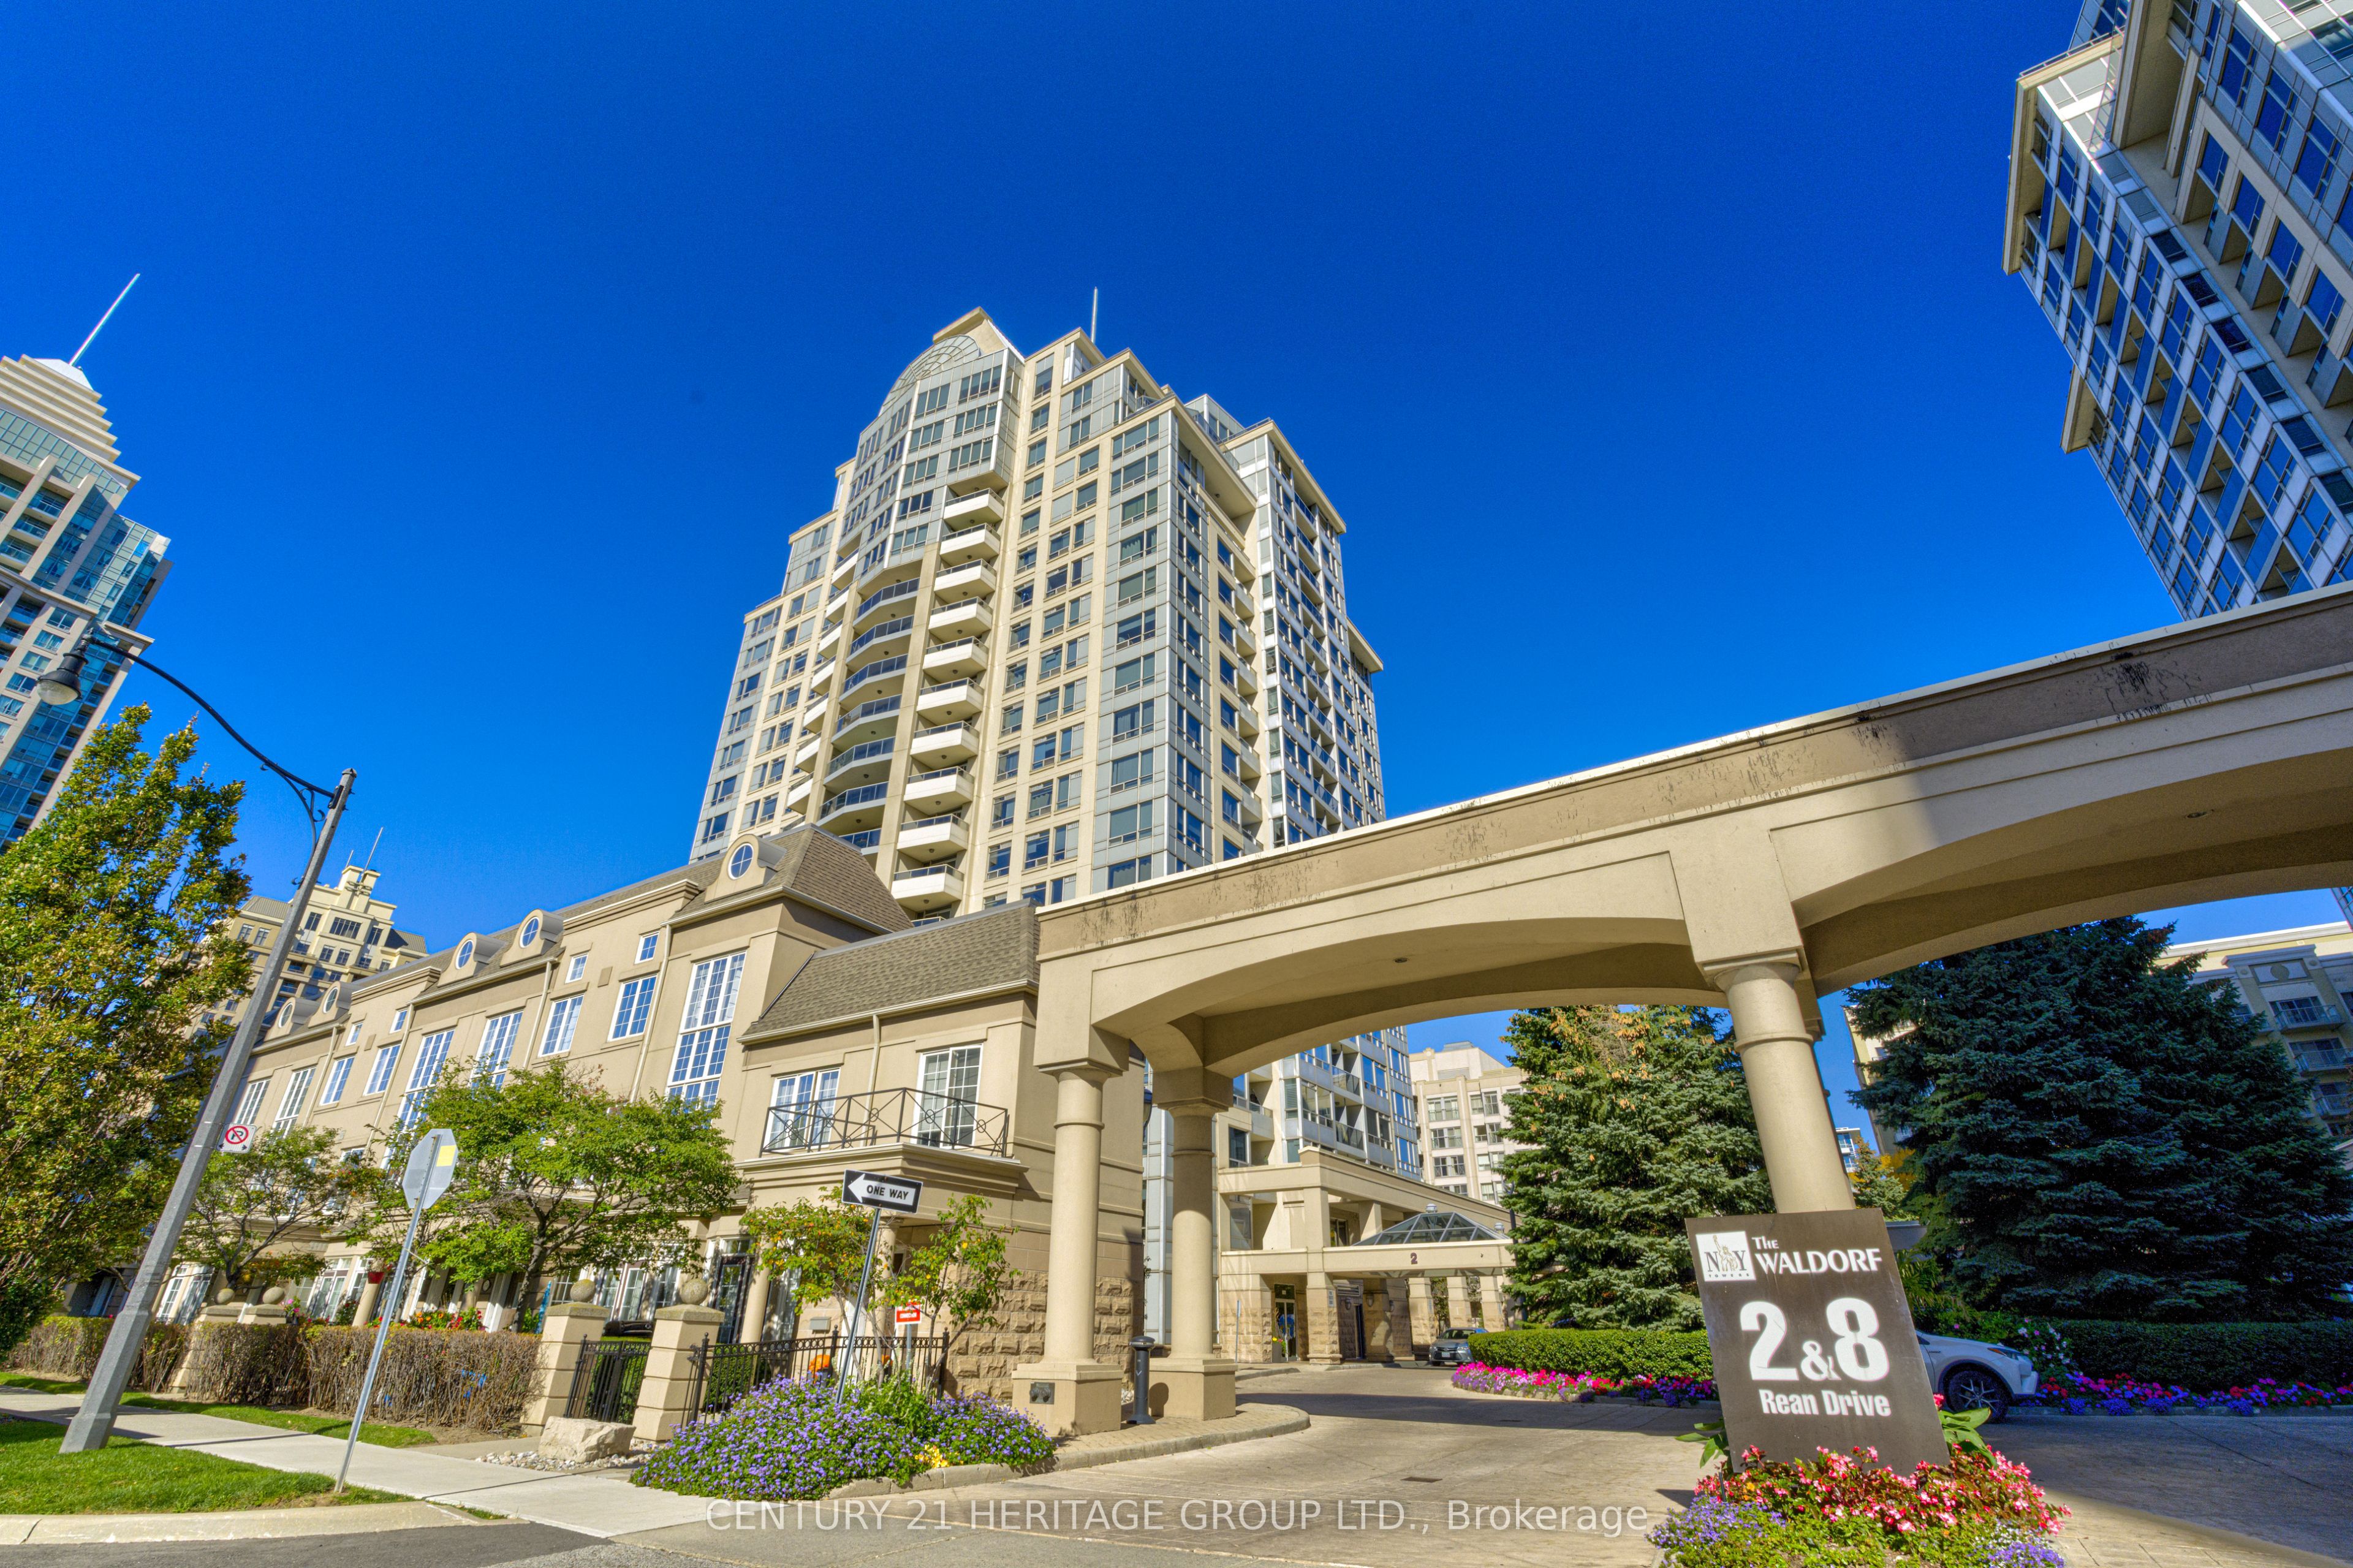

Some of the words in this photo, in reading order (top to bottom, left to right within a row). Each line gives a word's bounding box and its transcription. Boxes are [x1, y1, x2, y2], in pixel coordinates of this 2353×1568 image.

[866, 1184, 885, 1196] ONE
[889, 1188, 909, 1200] WAY
[1411, 1252, 1418, 1265] 2
[1754, 1248, 1883, 1274] WALDORF
[1759, 1389, 1819, 1415] Rean
[1821, 1390, 1892, 1417] Drive
